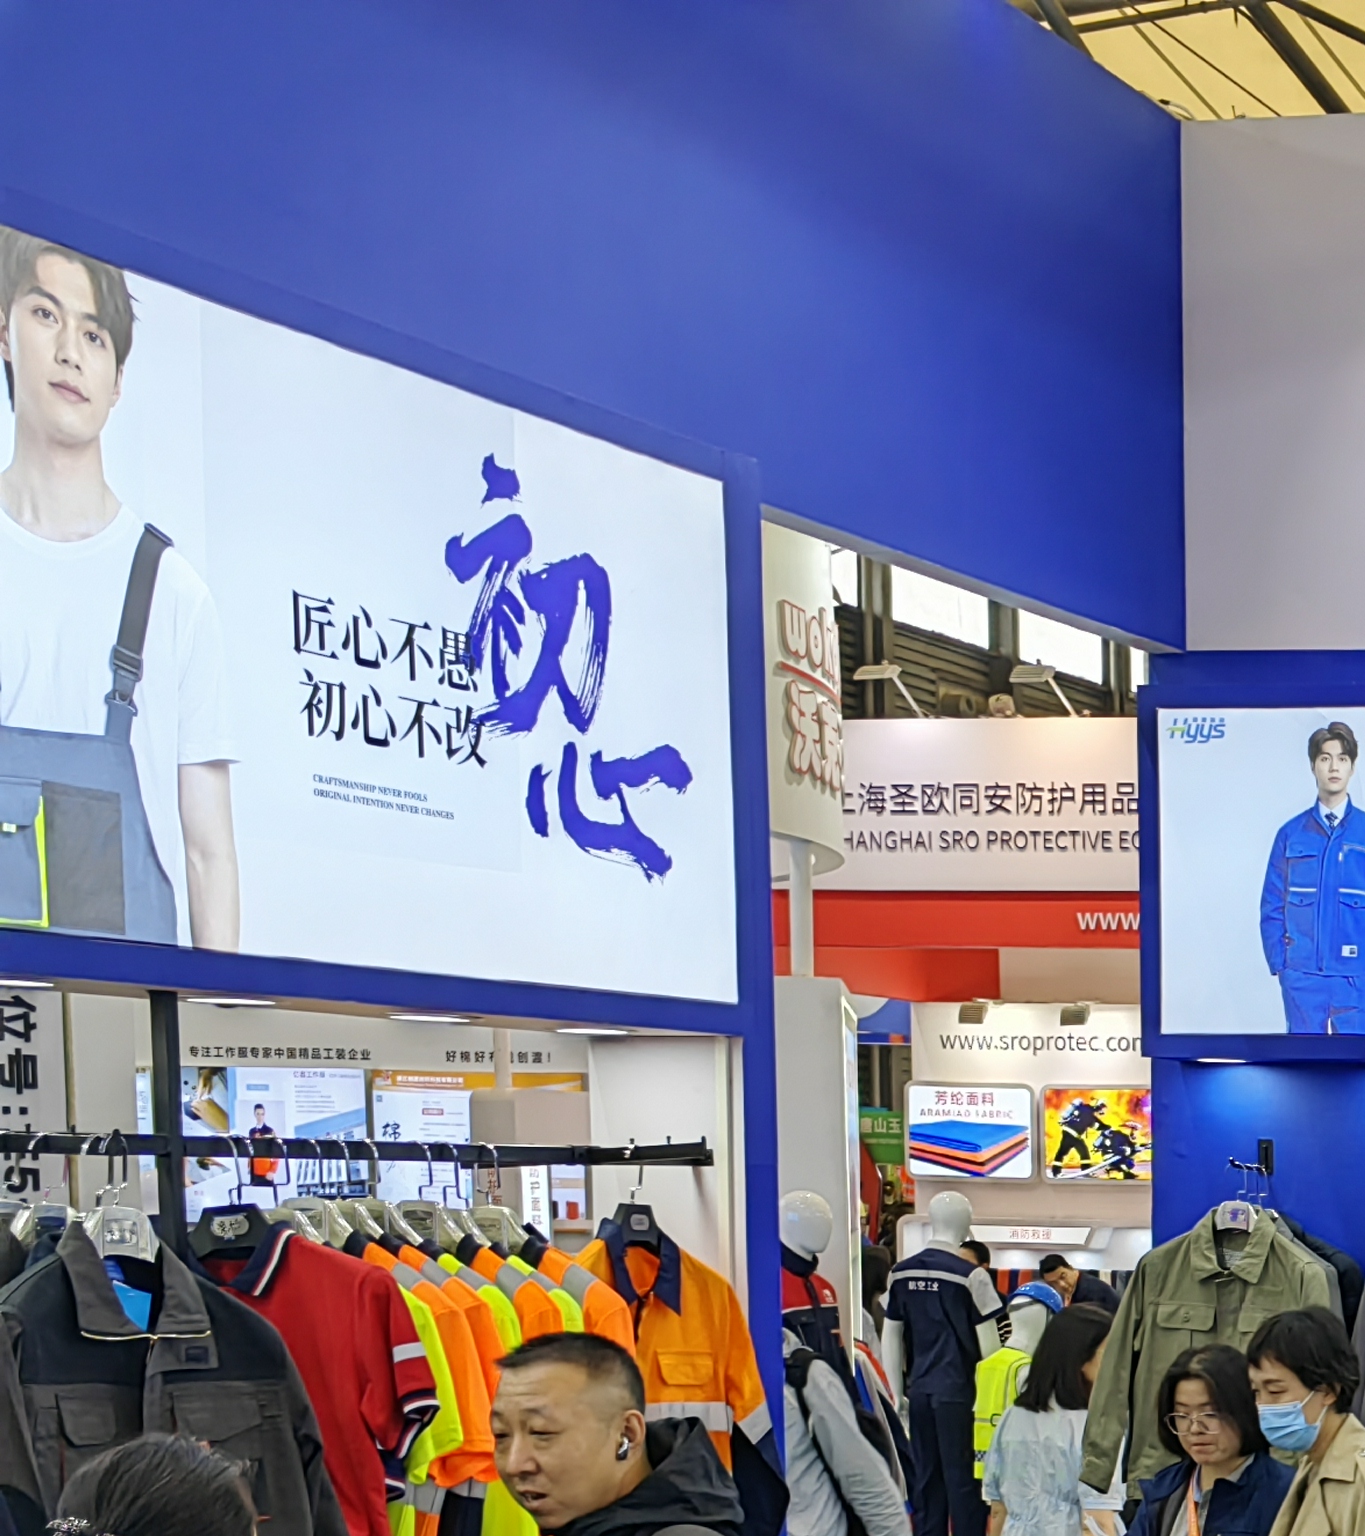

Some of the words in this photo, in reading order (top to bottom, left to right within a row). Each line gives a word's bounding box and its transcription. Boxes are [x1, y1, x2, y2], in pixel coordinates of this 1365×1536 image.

[292, 589, 478, 692] 匠心不愚
[299, 668, 488, 768] 初心不改
[313, 773, 377, 793] CRAFTSMANSHIP
[378, 785, 403, 799] NEVER
[404, 790, 428, 802] FOOLS
[313, 788, 352, 803] ORIGINAL
[353, 795, 394, 810] INTENTION
[395, 803, 420, 815] NEVER
[421, 807, 455, 820] CHANGES
[843, 830, 933, 851] HANGHAI
[939, 830, 980, 851] SRO
[987, 829, 1113, 850] PROTECTIVE
[189, 1045, 371, 1060] 专注工作服专家中国精品工装企业
[934, 1091, 995, 1107] 芳纶面料
